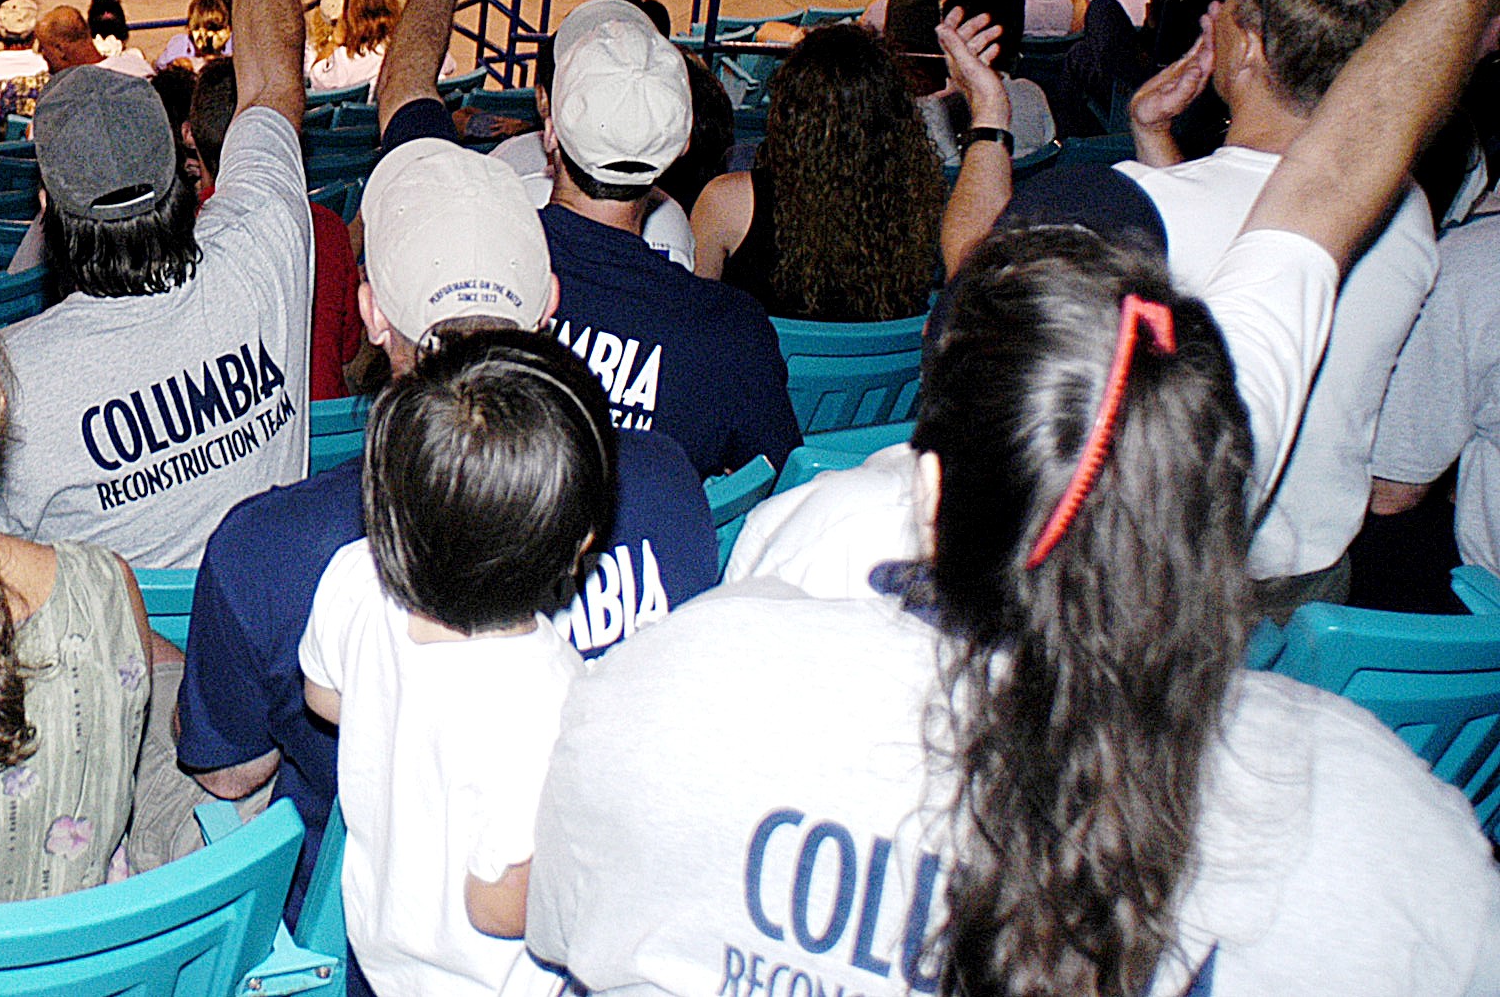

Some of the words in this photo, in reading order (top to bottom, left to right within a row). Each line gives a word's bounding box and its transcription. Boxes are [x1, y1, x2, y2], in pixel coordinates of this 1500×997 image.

[429, 280, 477, 305] PERFORMANCE
[457, 293, 478, 302] SINCE
[81, 337, 285, 471] COLUMBIA
[97, 421, 261, 510] RECONSTRUCTION
[256, 390, 297, 442] TEAM
